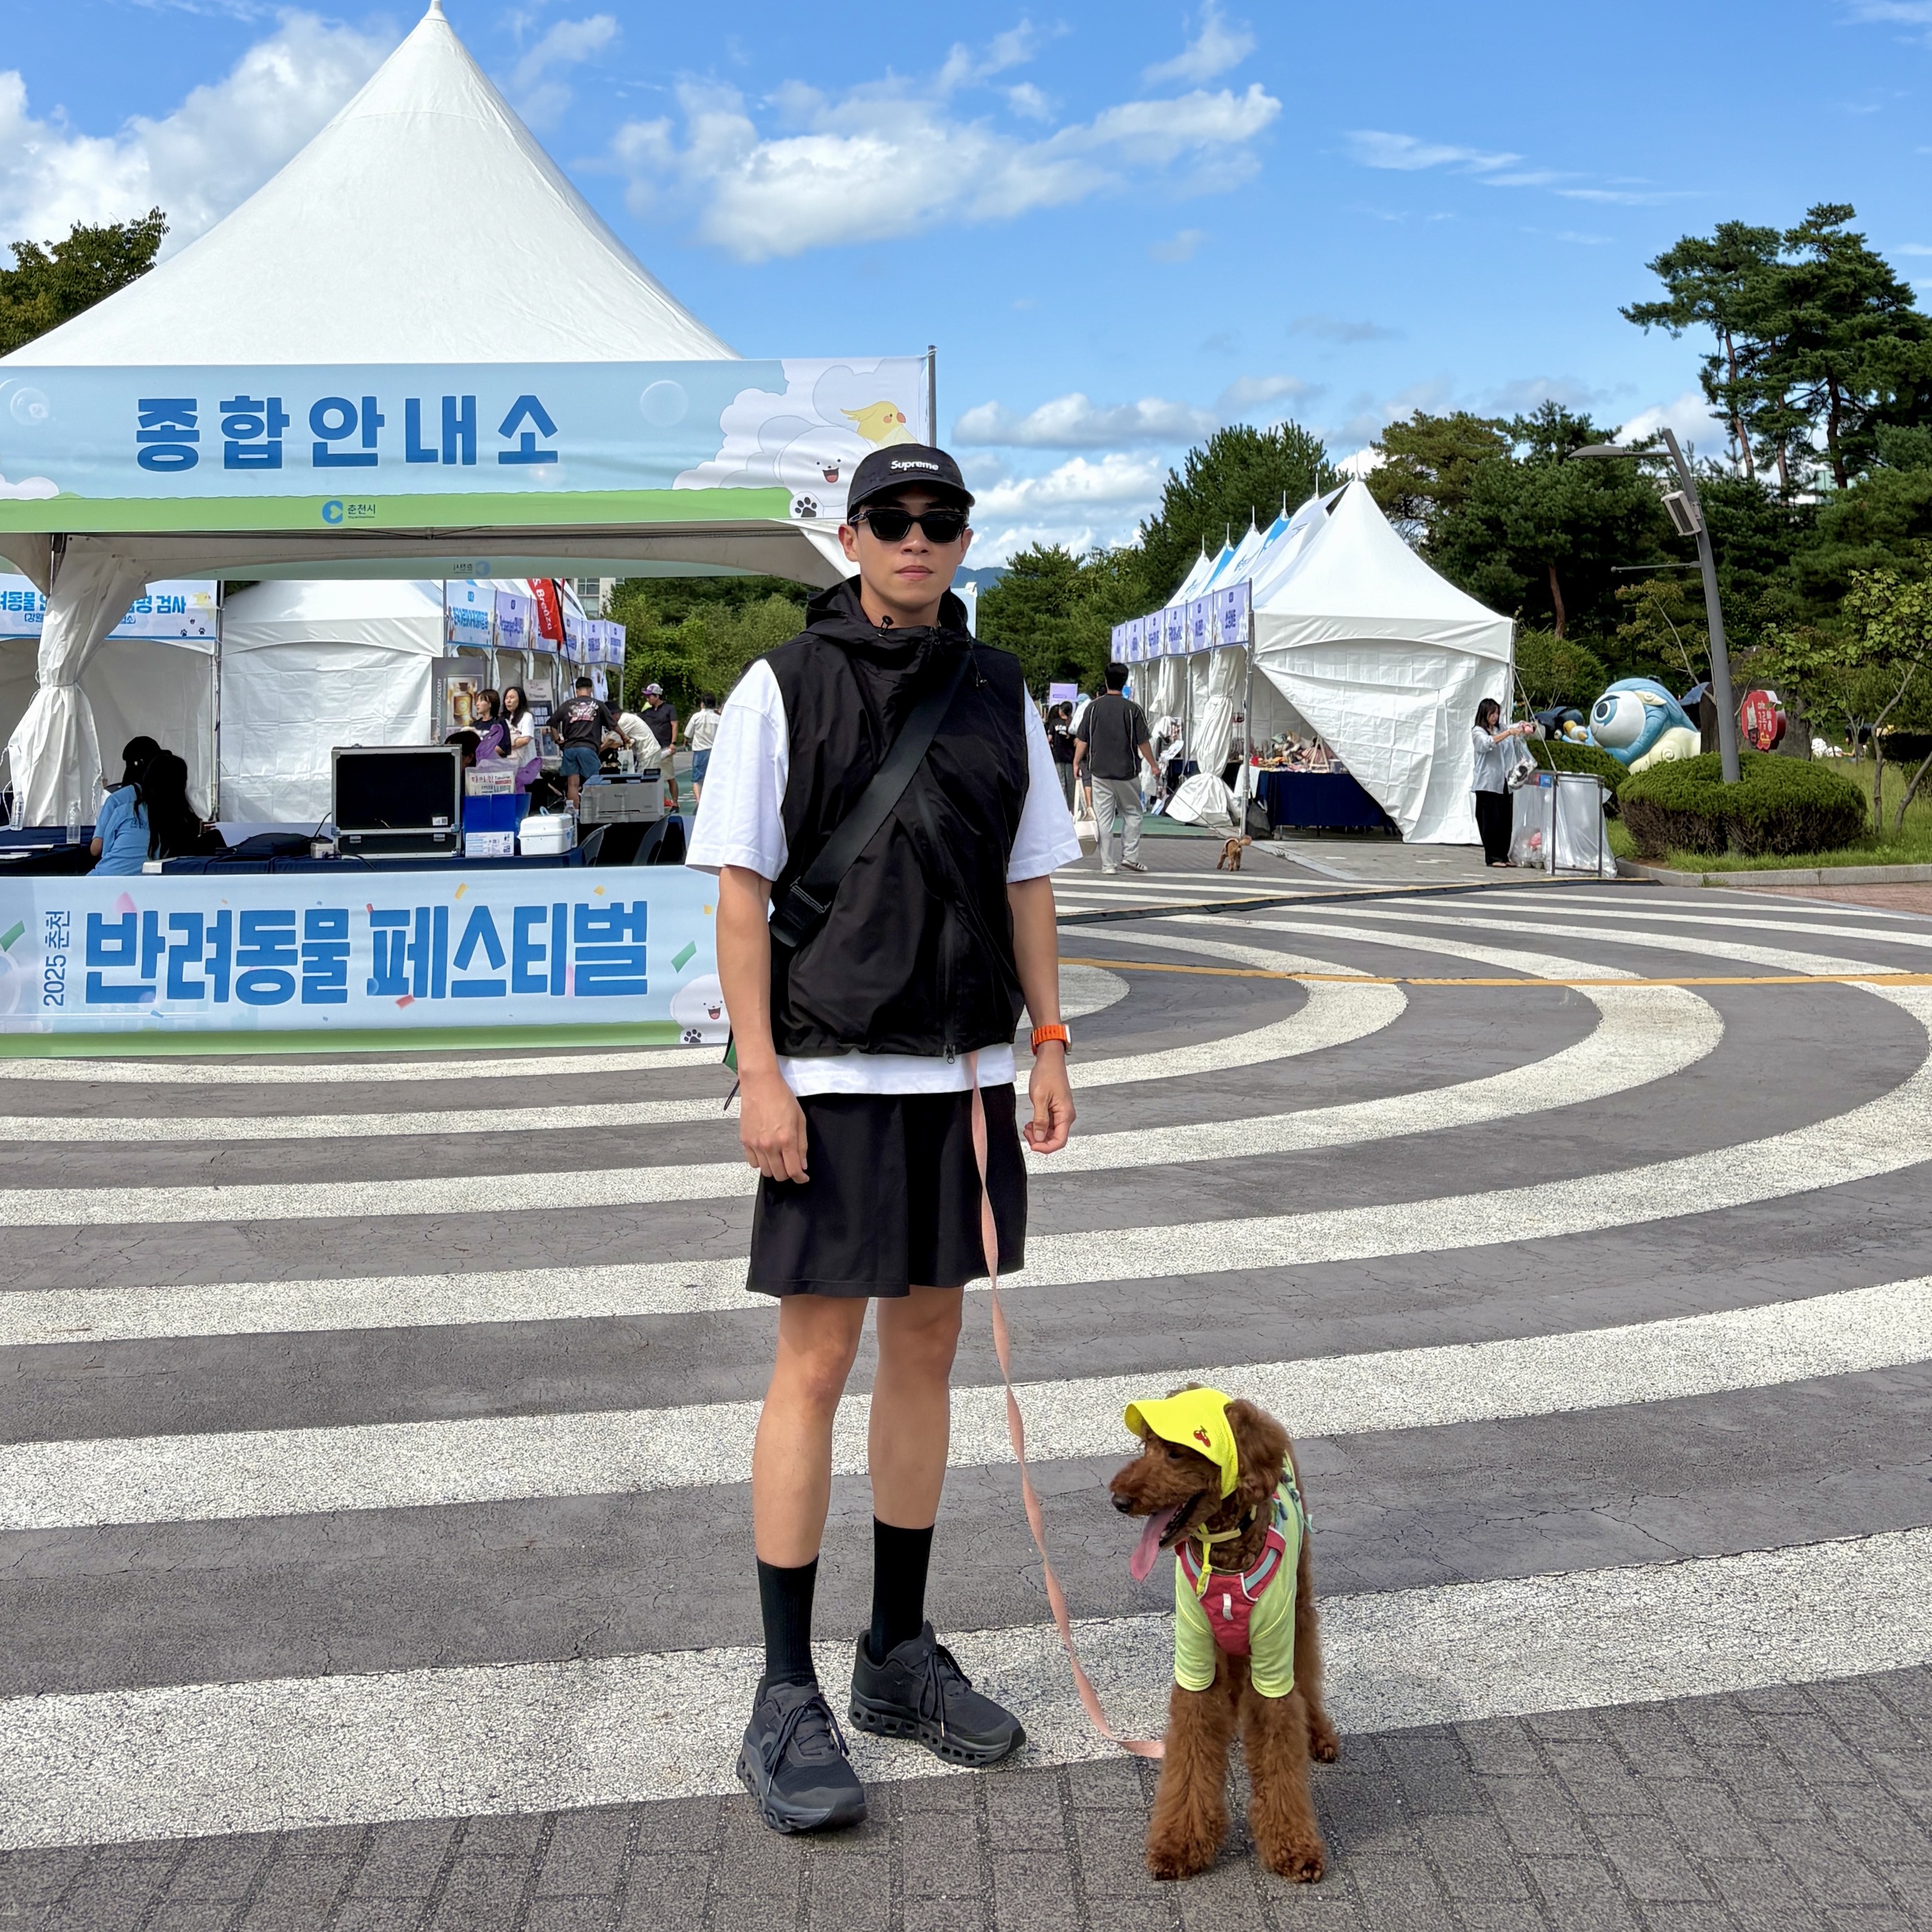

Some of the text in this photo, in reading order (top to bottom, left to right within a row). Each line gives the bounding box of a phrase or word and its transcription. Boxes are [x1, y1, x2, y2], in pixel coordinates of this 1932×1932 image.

[136, 395, 559, 473] 종합안내소
[890, 459, 939, 471] Supreme
[347, 503, 376, 515] 춘천시
[156, 595, 187, 614] 검사
[43, 910, 71, 1007] 2025 춘천
[85, 900, 648, 1007] 반려동물 페스티벌
